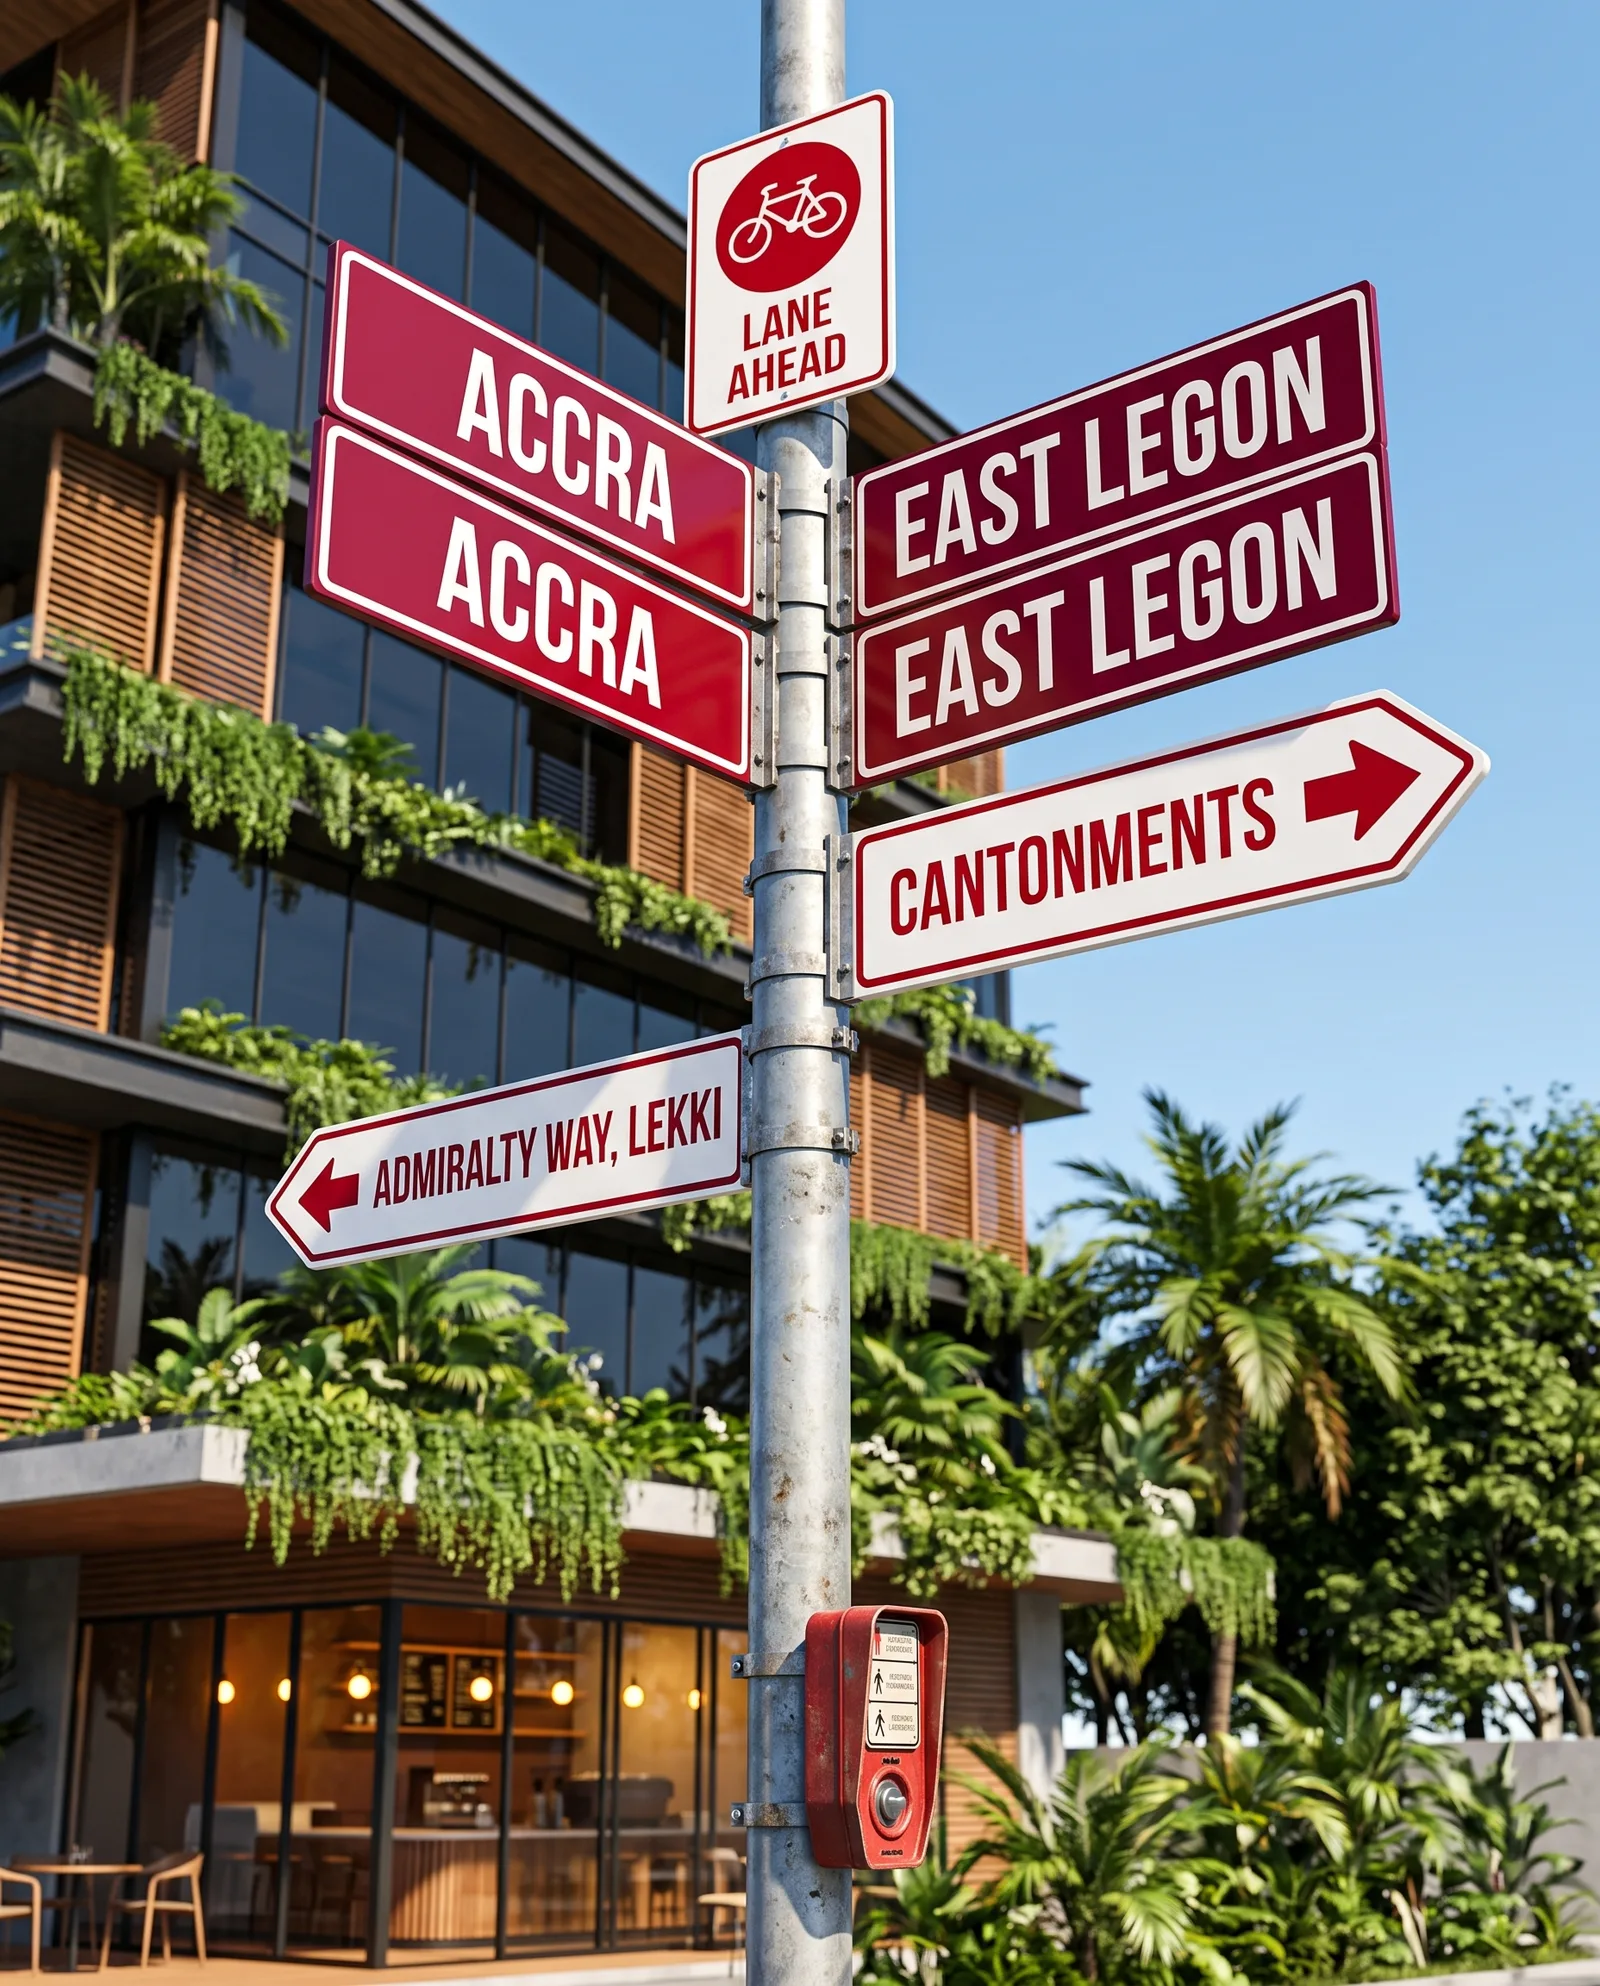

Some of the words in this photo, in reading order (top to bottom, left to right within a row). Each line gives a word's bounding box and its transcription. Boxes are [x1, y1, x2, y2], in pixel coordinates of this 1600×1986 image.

[727, 333, 846, 404] AHEAD
[743, 287, 832, 352] LANE
[456, 347, 676, 545] ACCRA
[895, 431, 1061, 578] EAST
[1084, 335, 1327, 511] LEGON
[436, 515, 662, 710] ACCRA
[895, 590, 1065, 738] EAST
[1089, 497, 1338, 675] LEGON
[890, 777, 1276, 936] CANTONMENTS
[372, 1126, 538, 1209] ADMIRALTY
[545, 1110, 618, 1173] WAY,
[629, 1086, 722, 1157] LEKKI
